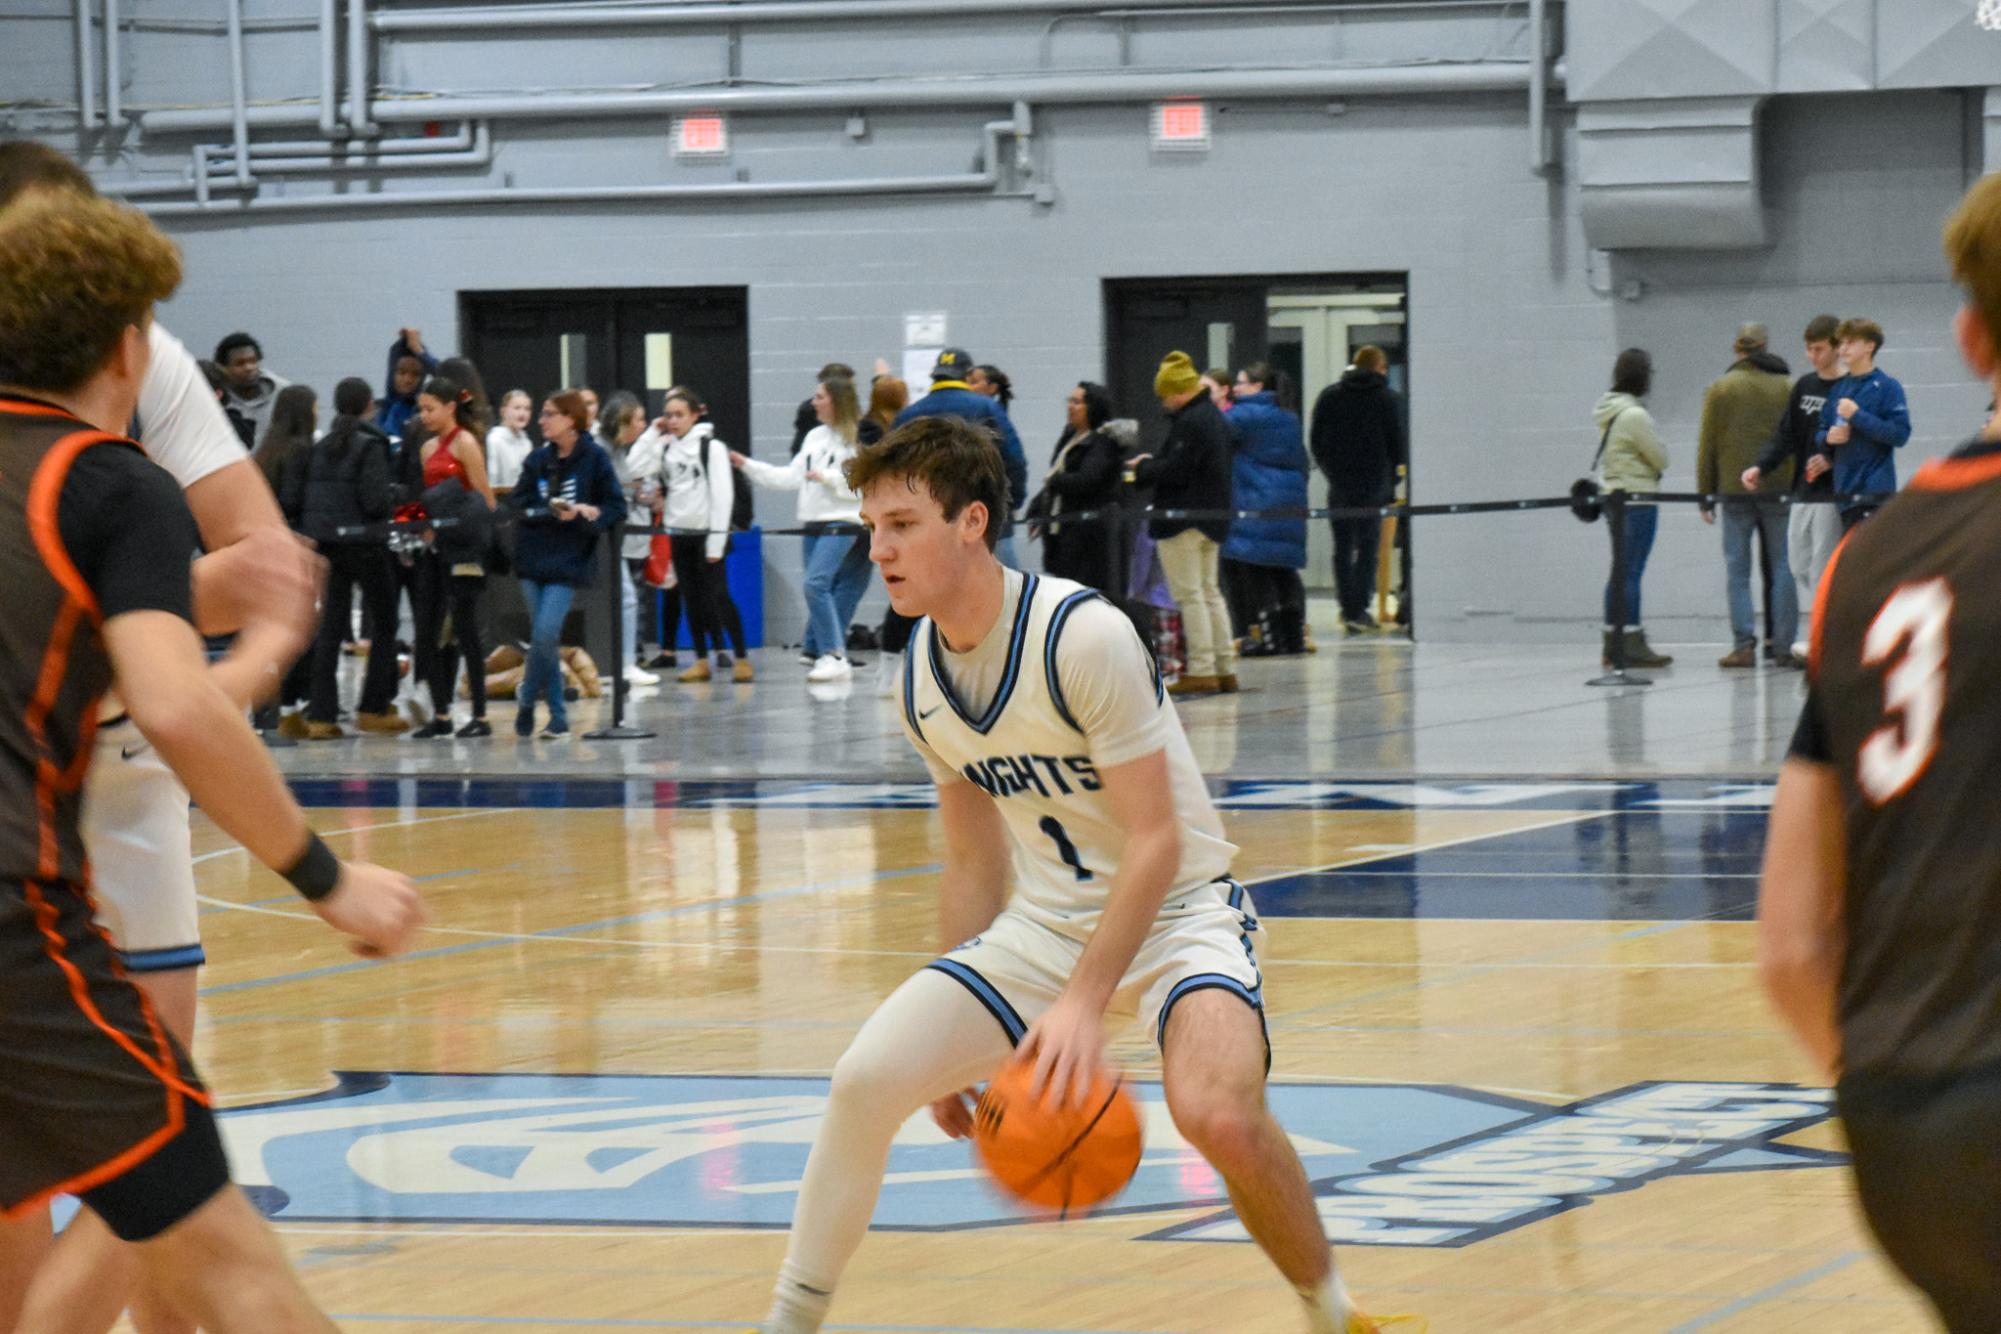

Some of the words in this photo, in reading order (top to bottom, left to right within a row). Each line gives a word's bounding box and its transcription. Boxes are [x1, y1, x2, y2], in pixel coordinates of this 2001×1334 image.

[1857, 577, 1954, 806] 3
[961, 754, 1103, 798] NIGHTS
[1039, 815, 1093, 881] 1
